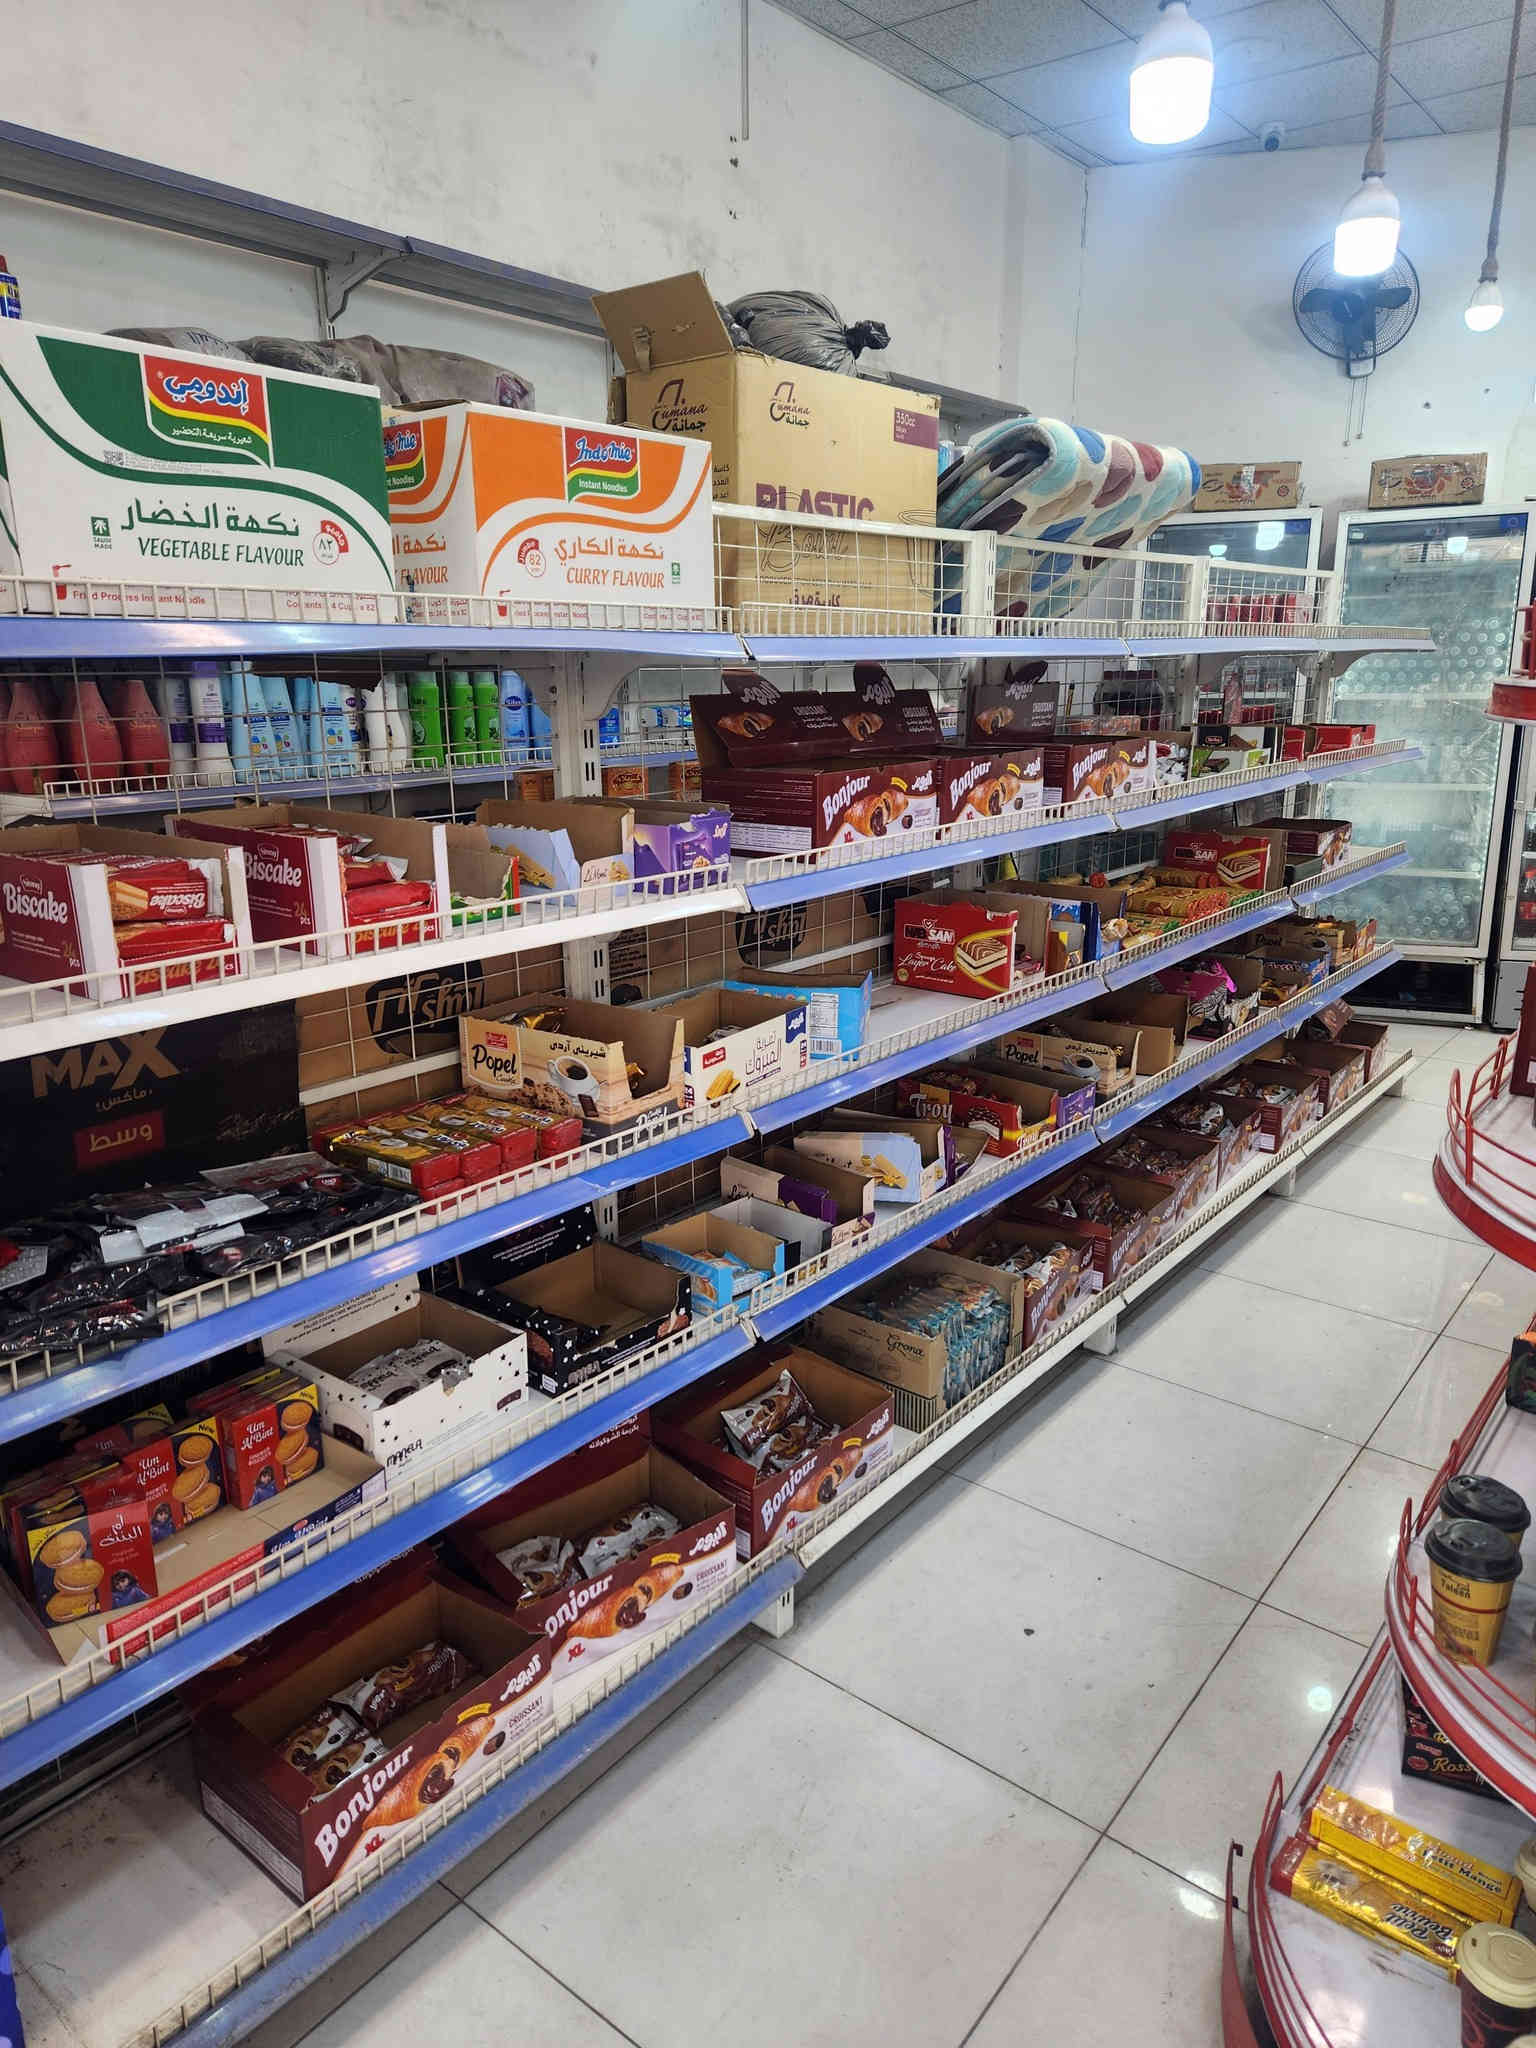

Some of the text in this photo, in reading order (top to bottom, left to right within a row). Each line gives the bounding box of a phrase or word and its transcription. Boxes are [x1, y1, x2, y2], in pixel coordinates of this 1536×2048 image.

[163, 376, 248, 415] إندومي
[578, 478, 628, 493] Instant Noodles
[121, 497, 219, 531] الخضار
[226, 506, 300, 536] نكهة
[138, 537, 304, 567] VEGETABLE FLAVOUR
[403, 533, 447, 554] نكهة
[553, 536, 664, 567] نكهة الكاري
[567, 567, 665, 589] CURRY FLAVOUR
[73, 590, 98, 600] Frid
[1073, 748, 1109, 791] Bonjour
[950, 760, 992, 811] Bonjour
[822, 774, 871, 832] Bonjour
[244, 852, 302, 887] Biscake
[3, 881, 68, 924] Biscake
[150, 892, 206, 909] Biscake
[928, 929, 953, 942] SAN
[31, 1026, 181, 1097] MAX
[471, 1043, 517, 1077] Popel
[1006, 1043, 1039, 1064] Popel
[89, 1124, 153, 1152] وسط
[198, 1423, 216, 1434] New
[246, 1420, 265, 1433] Um
[138, 1455, 160, 1469] Um
[761, 1456, 818, 1532] Bonjour
[545, 1574, 613, 1637] onjour
[314, 1744, 416, 1868] Bonjour
[1384, 1912, 1428, 1940] Petit
[1392, 1903, 1454, 1941] Beurre
